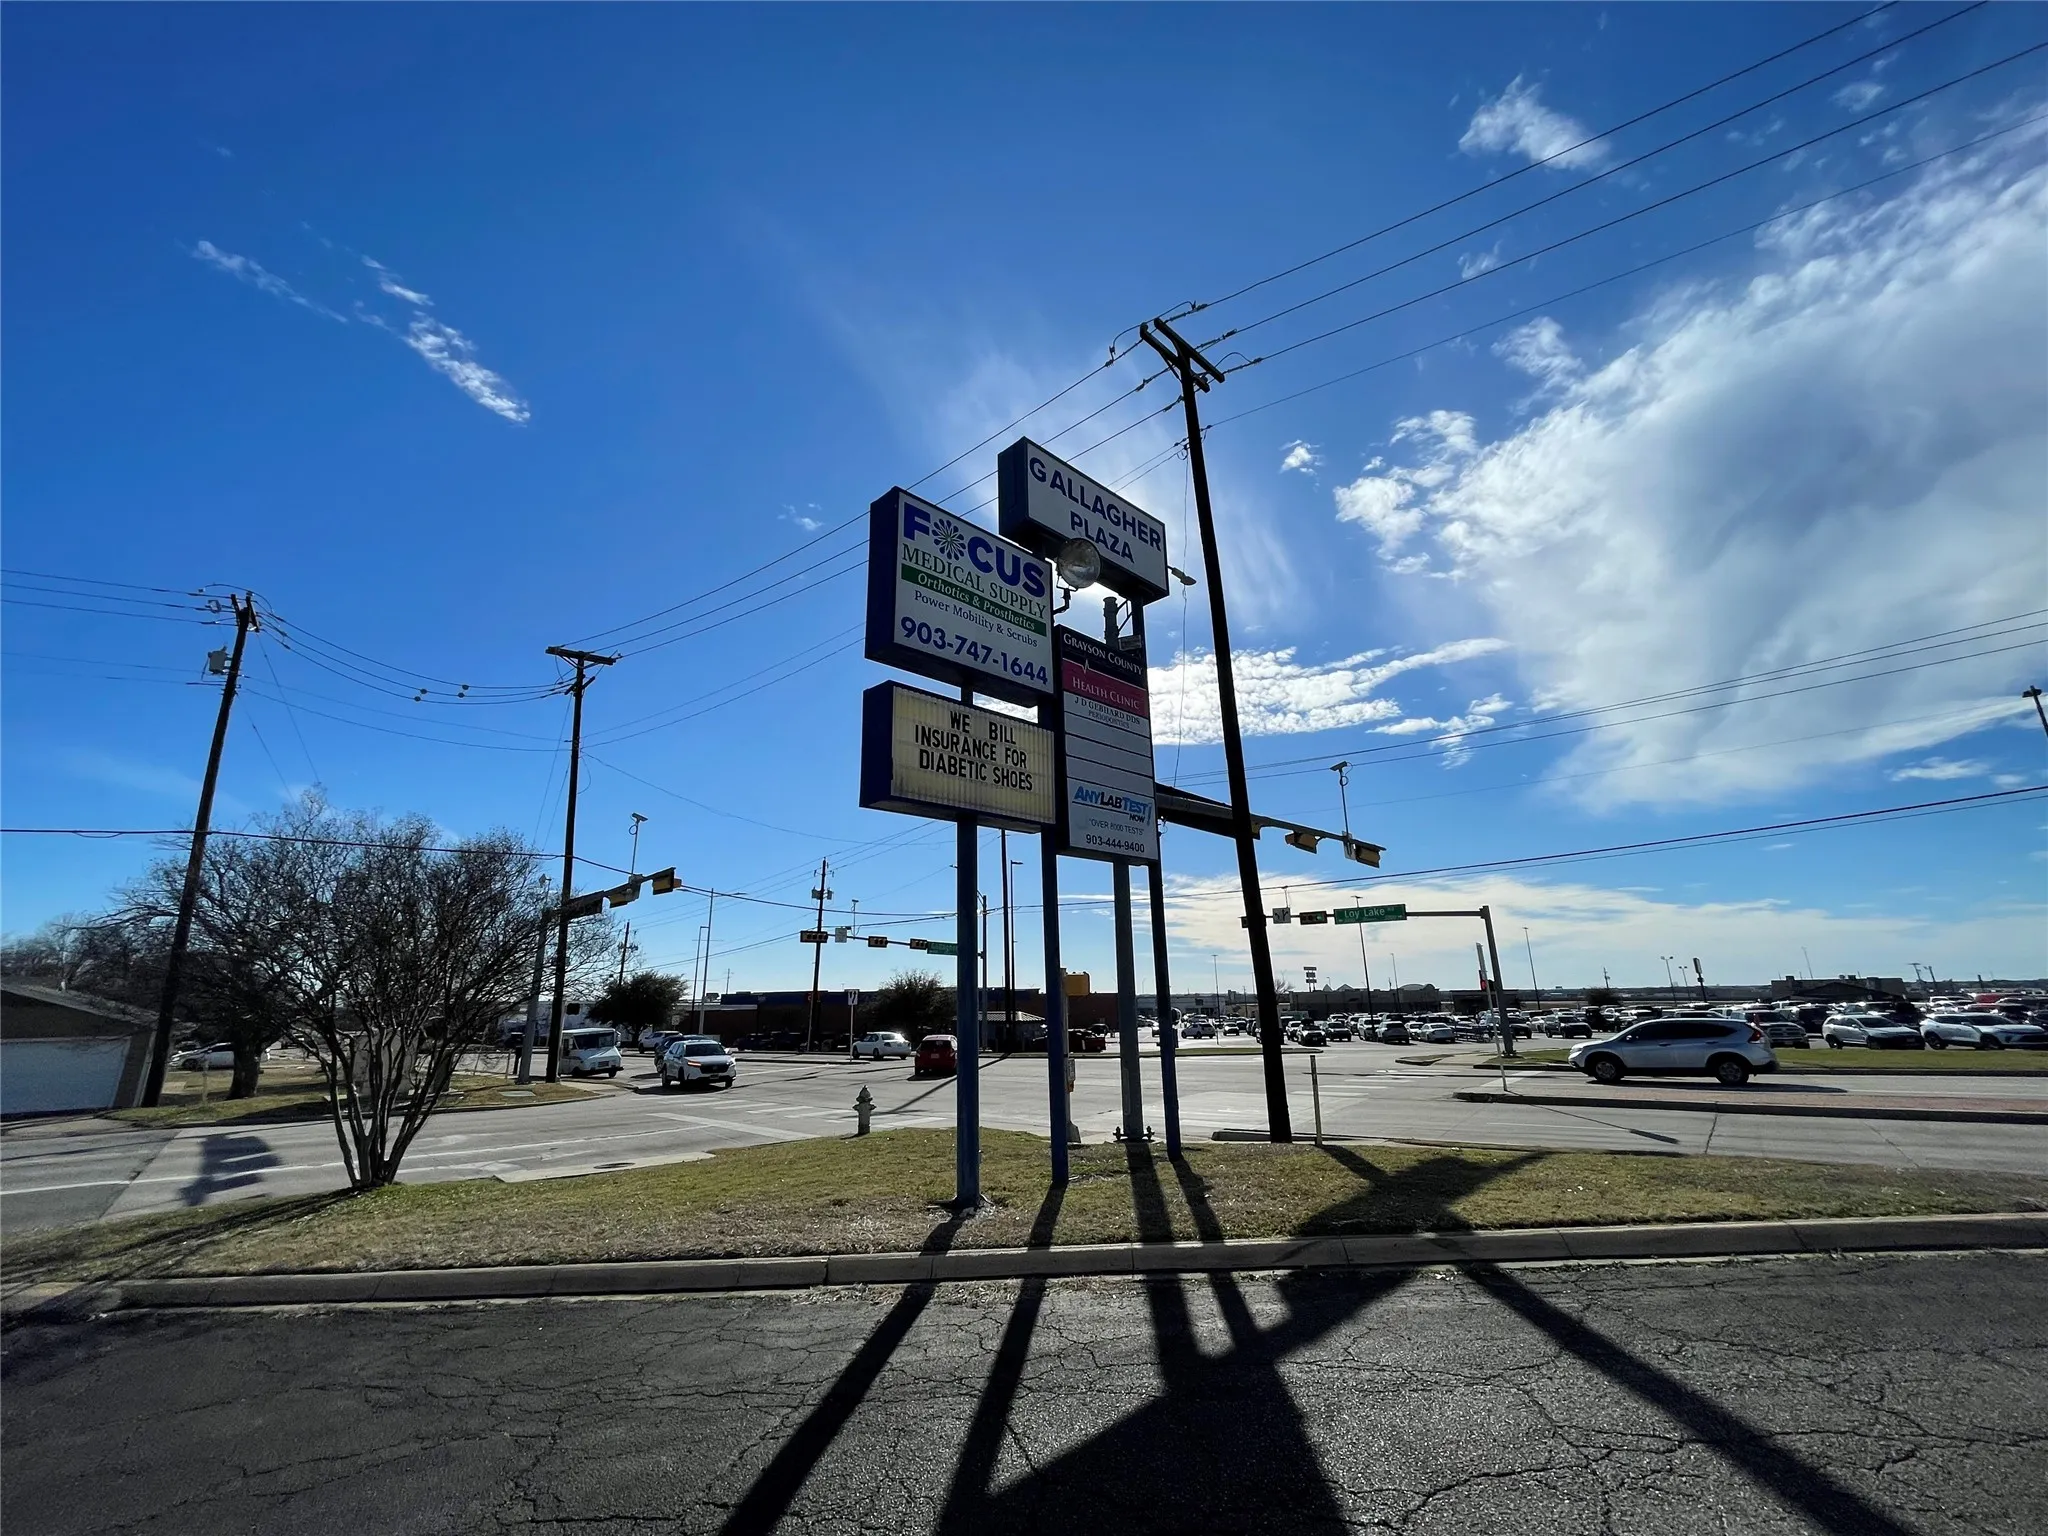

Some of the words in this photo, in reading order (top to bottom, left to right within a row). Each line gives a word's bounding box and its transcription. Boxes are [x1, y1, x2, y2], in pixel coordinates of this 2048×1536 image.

[1029, 456, 1161, 551] GALLAGHER
[1070, 510, 1135, 564] PLAZA
[902, 543, 985, 593] MEDICAL
[989, 583, 1047, 620] SUPPLY
[917, 573, 970, 604] Orthotics
[972, 593, 981, 607] &
[983, 596, 1035, 631] Prosthetics
[914, 590, 950, 614] Power
[952, 602, 994, 634] Mobility
[996, 622, 1004, 634] &
[1006, 627, 1038, 648] Scrubs
[900, 616, 1048, 685] 903-747-1644
[1063, 633, 1106, 659] GRAYSON
[1107, 652, 1143, 675] COUNTY
[1072, 677, 1107, 699] HEALTH
[1110, 691, 1140, 709] CLINIC
[1081, 698, 1087, 707] D
[1126, 714, 1140, 725] DDS
[915, 725, 997, 761] INSURANCE
[1004, 747, 1027, 769] FOR
[950, 711, 970, 733] WE
[988, 721, 1016, 745] BILL
[919, 749, 987, 781] DIABETIC
[993, 766, 1033, 791] SHOES
[1129, 813, 1146, 823] NOW
[1085, 833, 1145, 853] 903-444-9400
[1344, 910, 1360, 919] Loy
[1363, 907, 1386, 917] Lake
